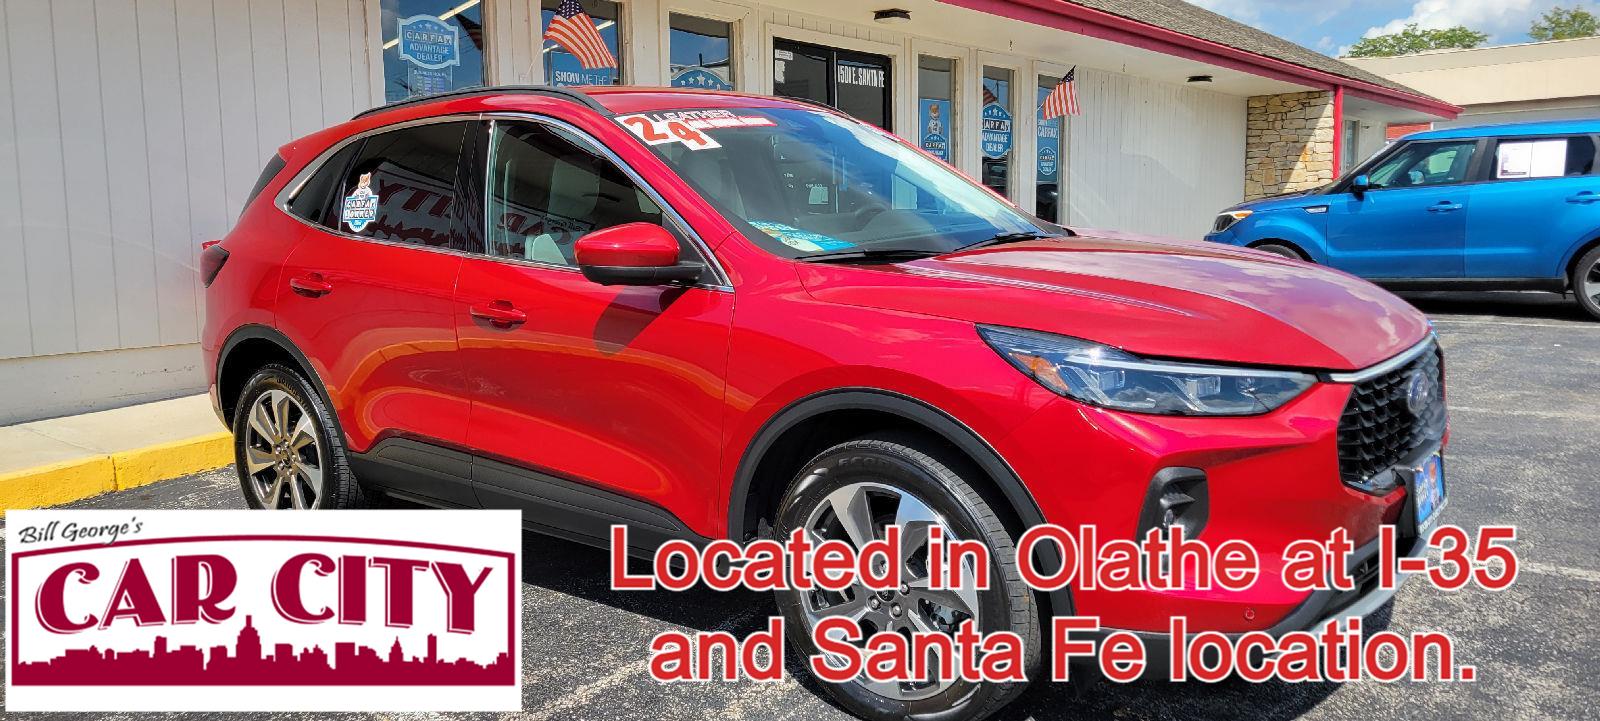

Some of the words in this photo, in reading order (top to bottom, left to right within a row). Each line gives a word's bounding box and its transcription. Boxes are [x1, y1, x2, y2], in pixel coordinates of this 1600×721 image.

[406, 30, 452, 45] CARFAX
[409, 42, 449, 54] ADVANTAGE
[416, 53, 443, 62] DEALER
[555, 71, 580, 83] SHOW
[837, 65, 852, 84] 1501
[858, 68, 878, 87] SANTA
[878, 70, 885, 88] FE
[985, 142, 1004, 152] DEALER
